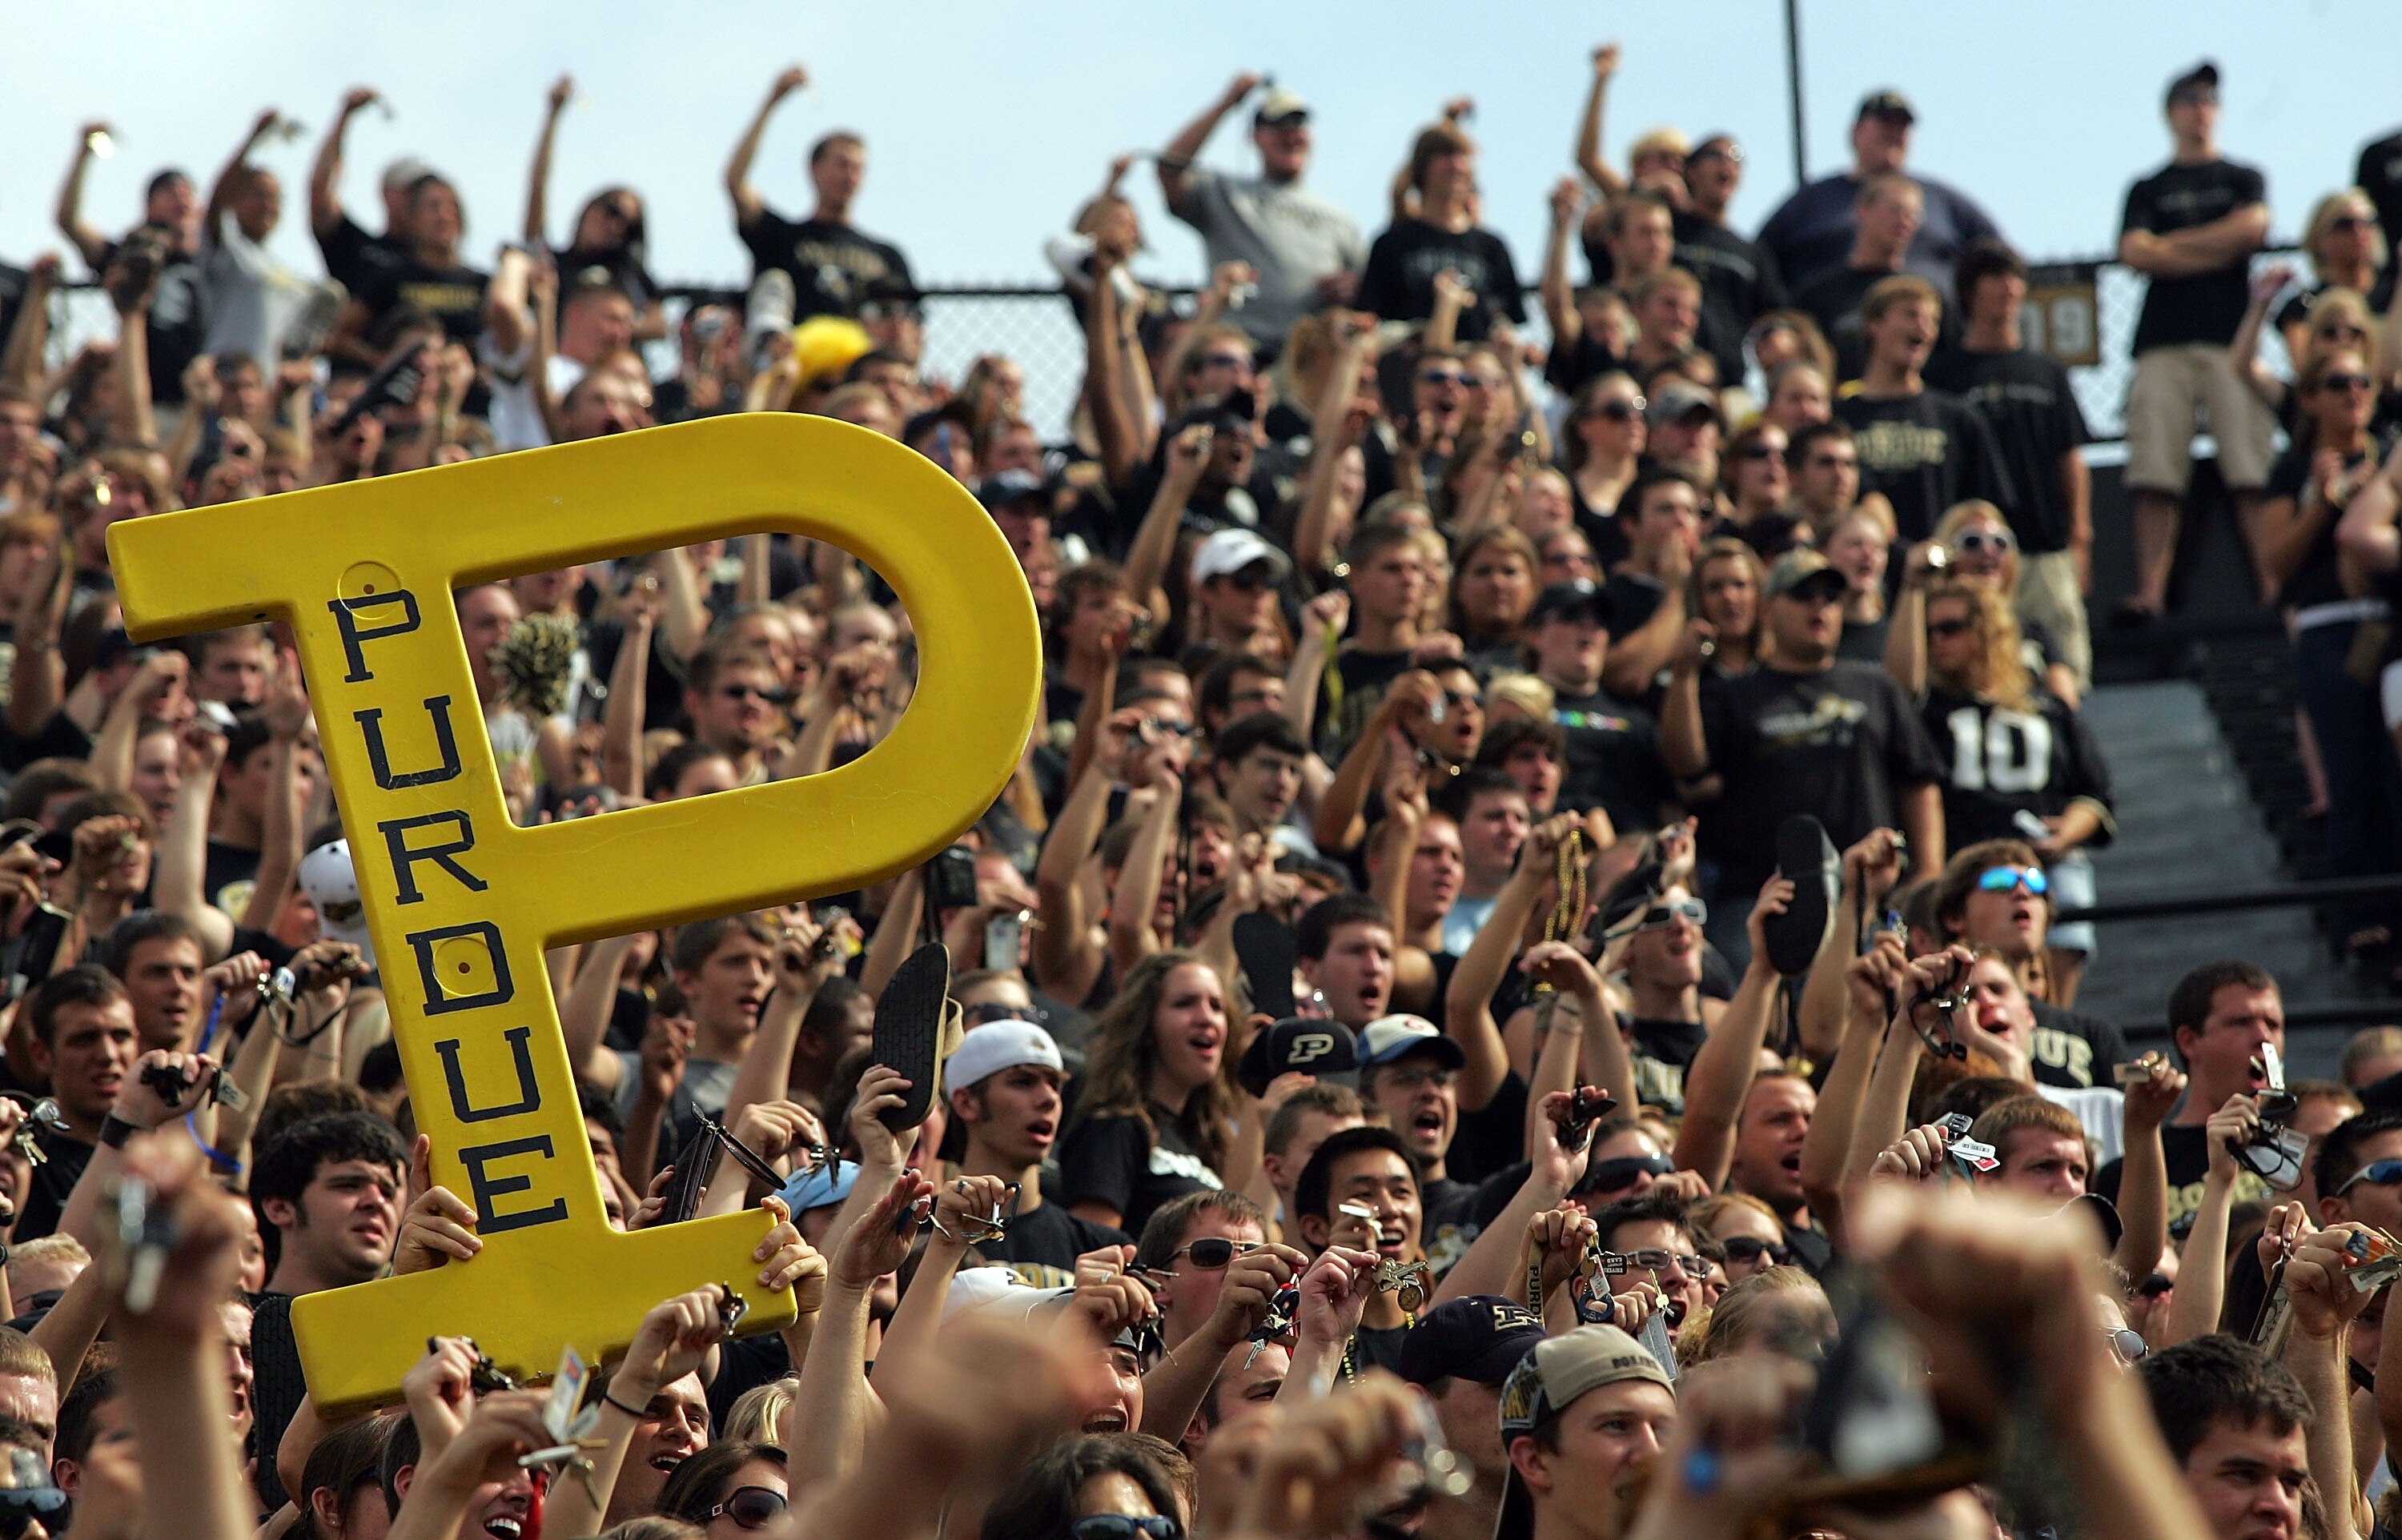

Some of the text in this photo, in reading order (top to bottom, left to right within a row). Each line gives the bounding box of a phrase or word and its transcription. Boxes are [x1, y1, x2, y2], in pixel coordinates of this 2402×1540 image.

[1946, 704, 2052, 793] 10
[106, 411, 1042, 1418] P
[327, 588, 569, 1236] PURDUE
[1287, 1033, 1334, 1065] P
[1528, 1266, 1542, 1318] PURD
